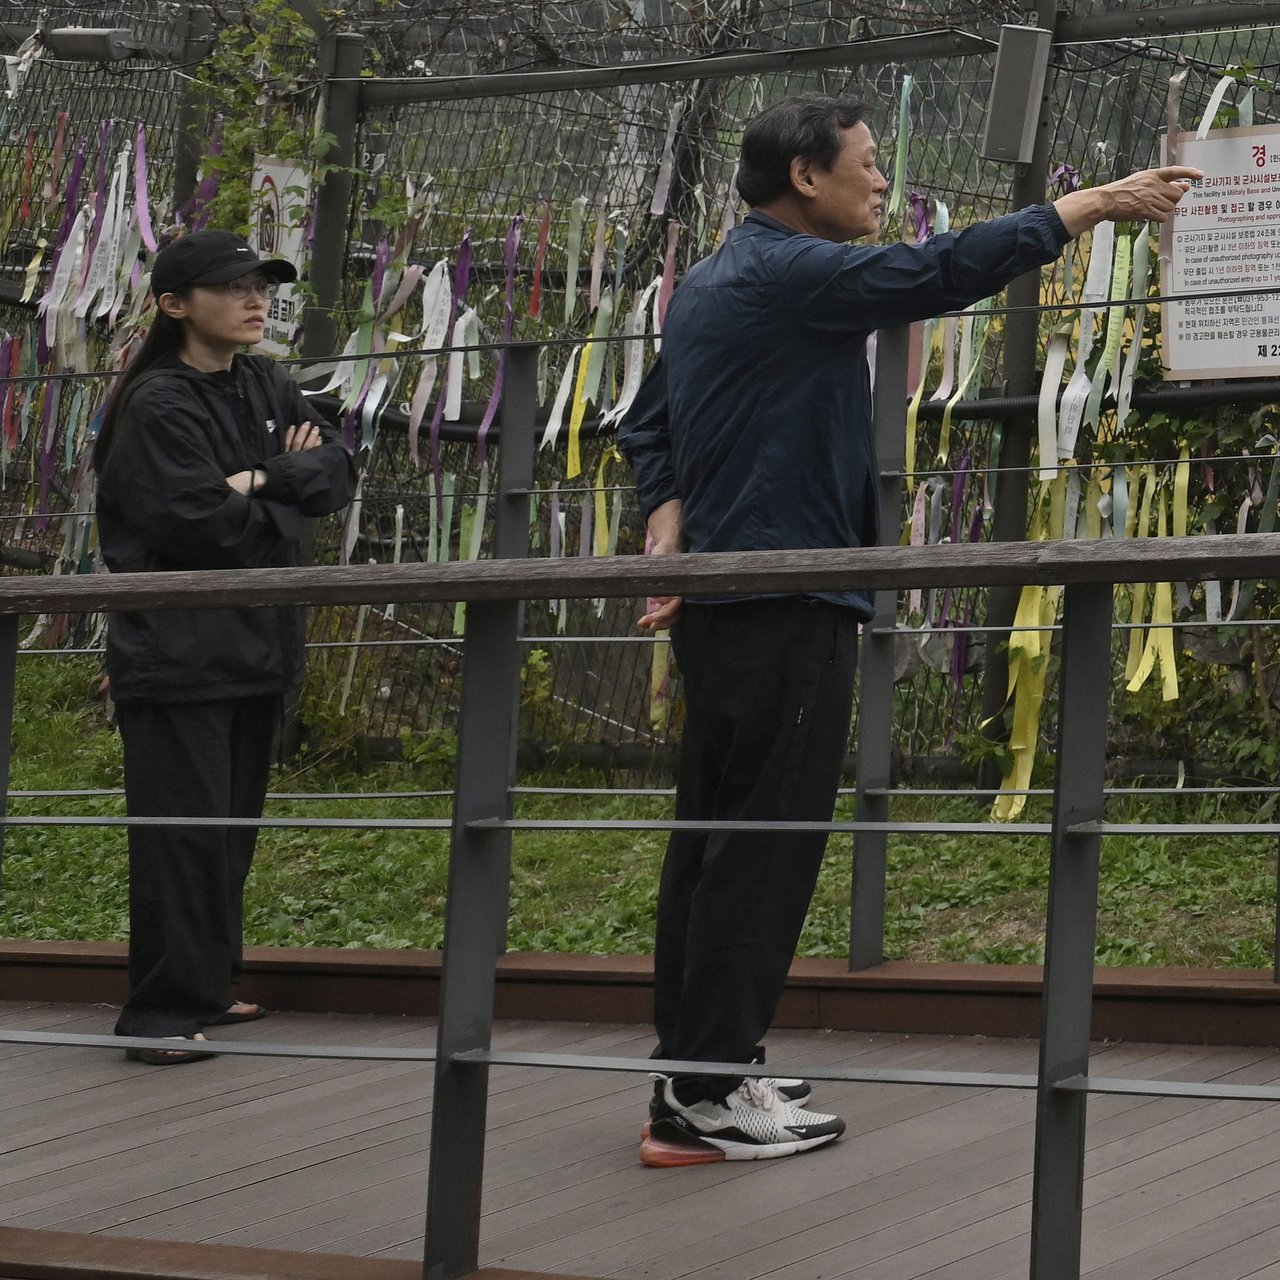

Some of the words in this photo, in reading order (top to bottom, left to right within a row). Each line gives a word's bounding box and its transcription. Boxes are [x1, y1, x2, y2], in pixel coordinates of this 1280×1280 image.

[1252, 145, 1266, 167] 경
[1205, 176, 1232, 187] 군사기지
[1234, 176, 1240, 186] 및
[1204, 190, 1221, 198] facility
[1174, 206, 1188, 217] 무단
[1190, 204, 1218, 215] 사진촬영
[1221, 204, 1228, 214] 및
[1230, 202, 1245, 213] 접근
[1247, 202, 1255, 212] 할
[1258, 200, 1272, 212] 경우
[1217, 215, 1255, 223] Photographing
[1184, 234, 1206, 242] 군사기지
[1207, 233, 1213, 241] 및
[1214, 231, 1236, 241] 군사시설
[1238, 230, 1255, 239] 보호법
[1256, 228, 1276, 237] 24조에
[1184, 245, 1195, 254] 무단
[1220, 243, 1226, 251] 시
[1227, 242, 1239, 251] 3년
[1238, 242, 1256, 250] 이하의
[1257, 240, 1269, 249] 징역
[1209, 253, 1241, 262] unauthorized
[1241, 252, 1274, 261] photography
[1183, 268, 1194, 277] 무단
[1209, 266, 1214, 274] 시
[1216, 265, 1224, 274] 1년
[1226, 264, 1243, 274] 이하의
[1244, 263, 1257, 273] 징역
[1257, 263, 1270, 272] 또는
[1208, 276, 1240, 285] unauthorized
[1241, 276, 1255, 284] entry
[1263, 274, 1269, 282] to
[1223, 317, 1240, 326] 지역은
[1185, 333, 1192, 341] 이
[1258, 345, 1268, 357] 제
